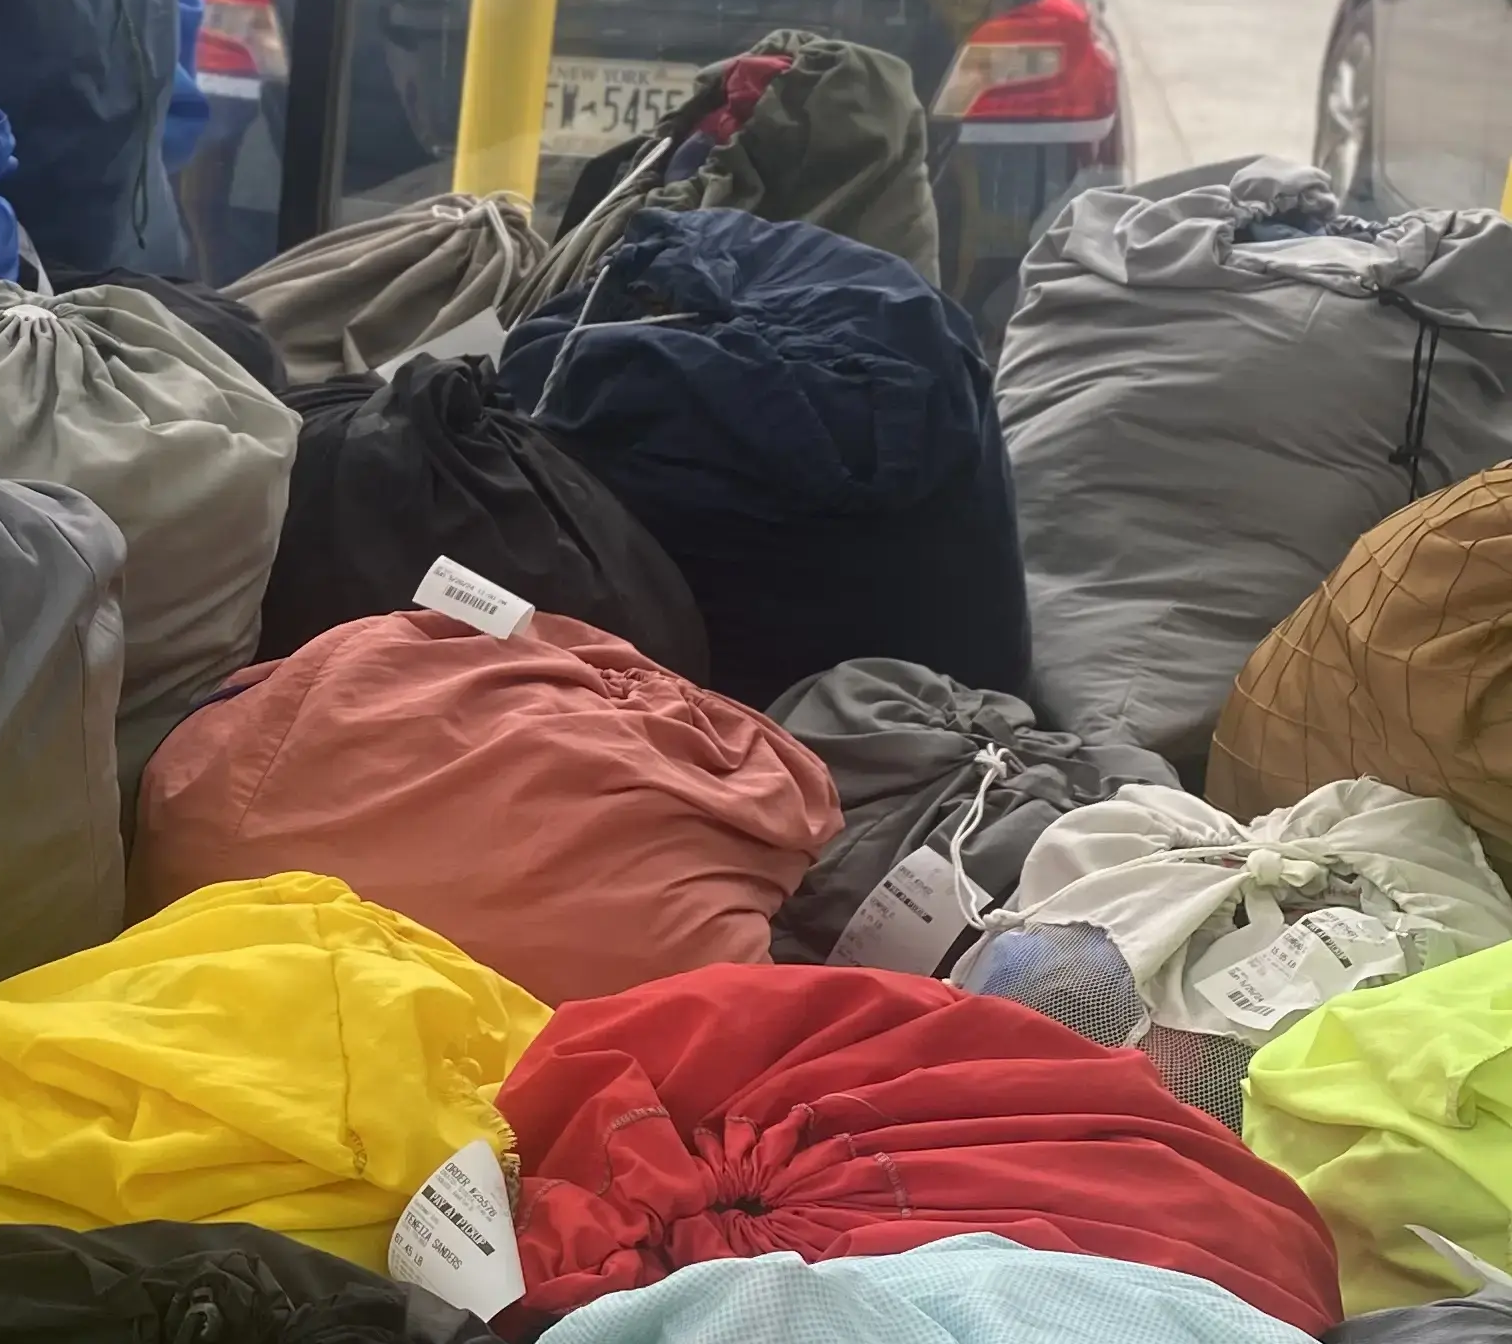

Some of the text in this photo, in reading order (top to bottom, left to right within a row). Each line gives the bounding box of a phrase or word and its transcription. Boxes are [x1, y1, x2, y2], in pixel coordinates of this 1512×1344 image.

[603, 67, 650, 86] YORK
[445, 1162, 471, 1187] ORDER
[429, 1192, 447, 1209] PAY
[455, 1218, 489, 1246] PICKUP
[431, 1238, 463, 1270] SANDERS
